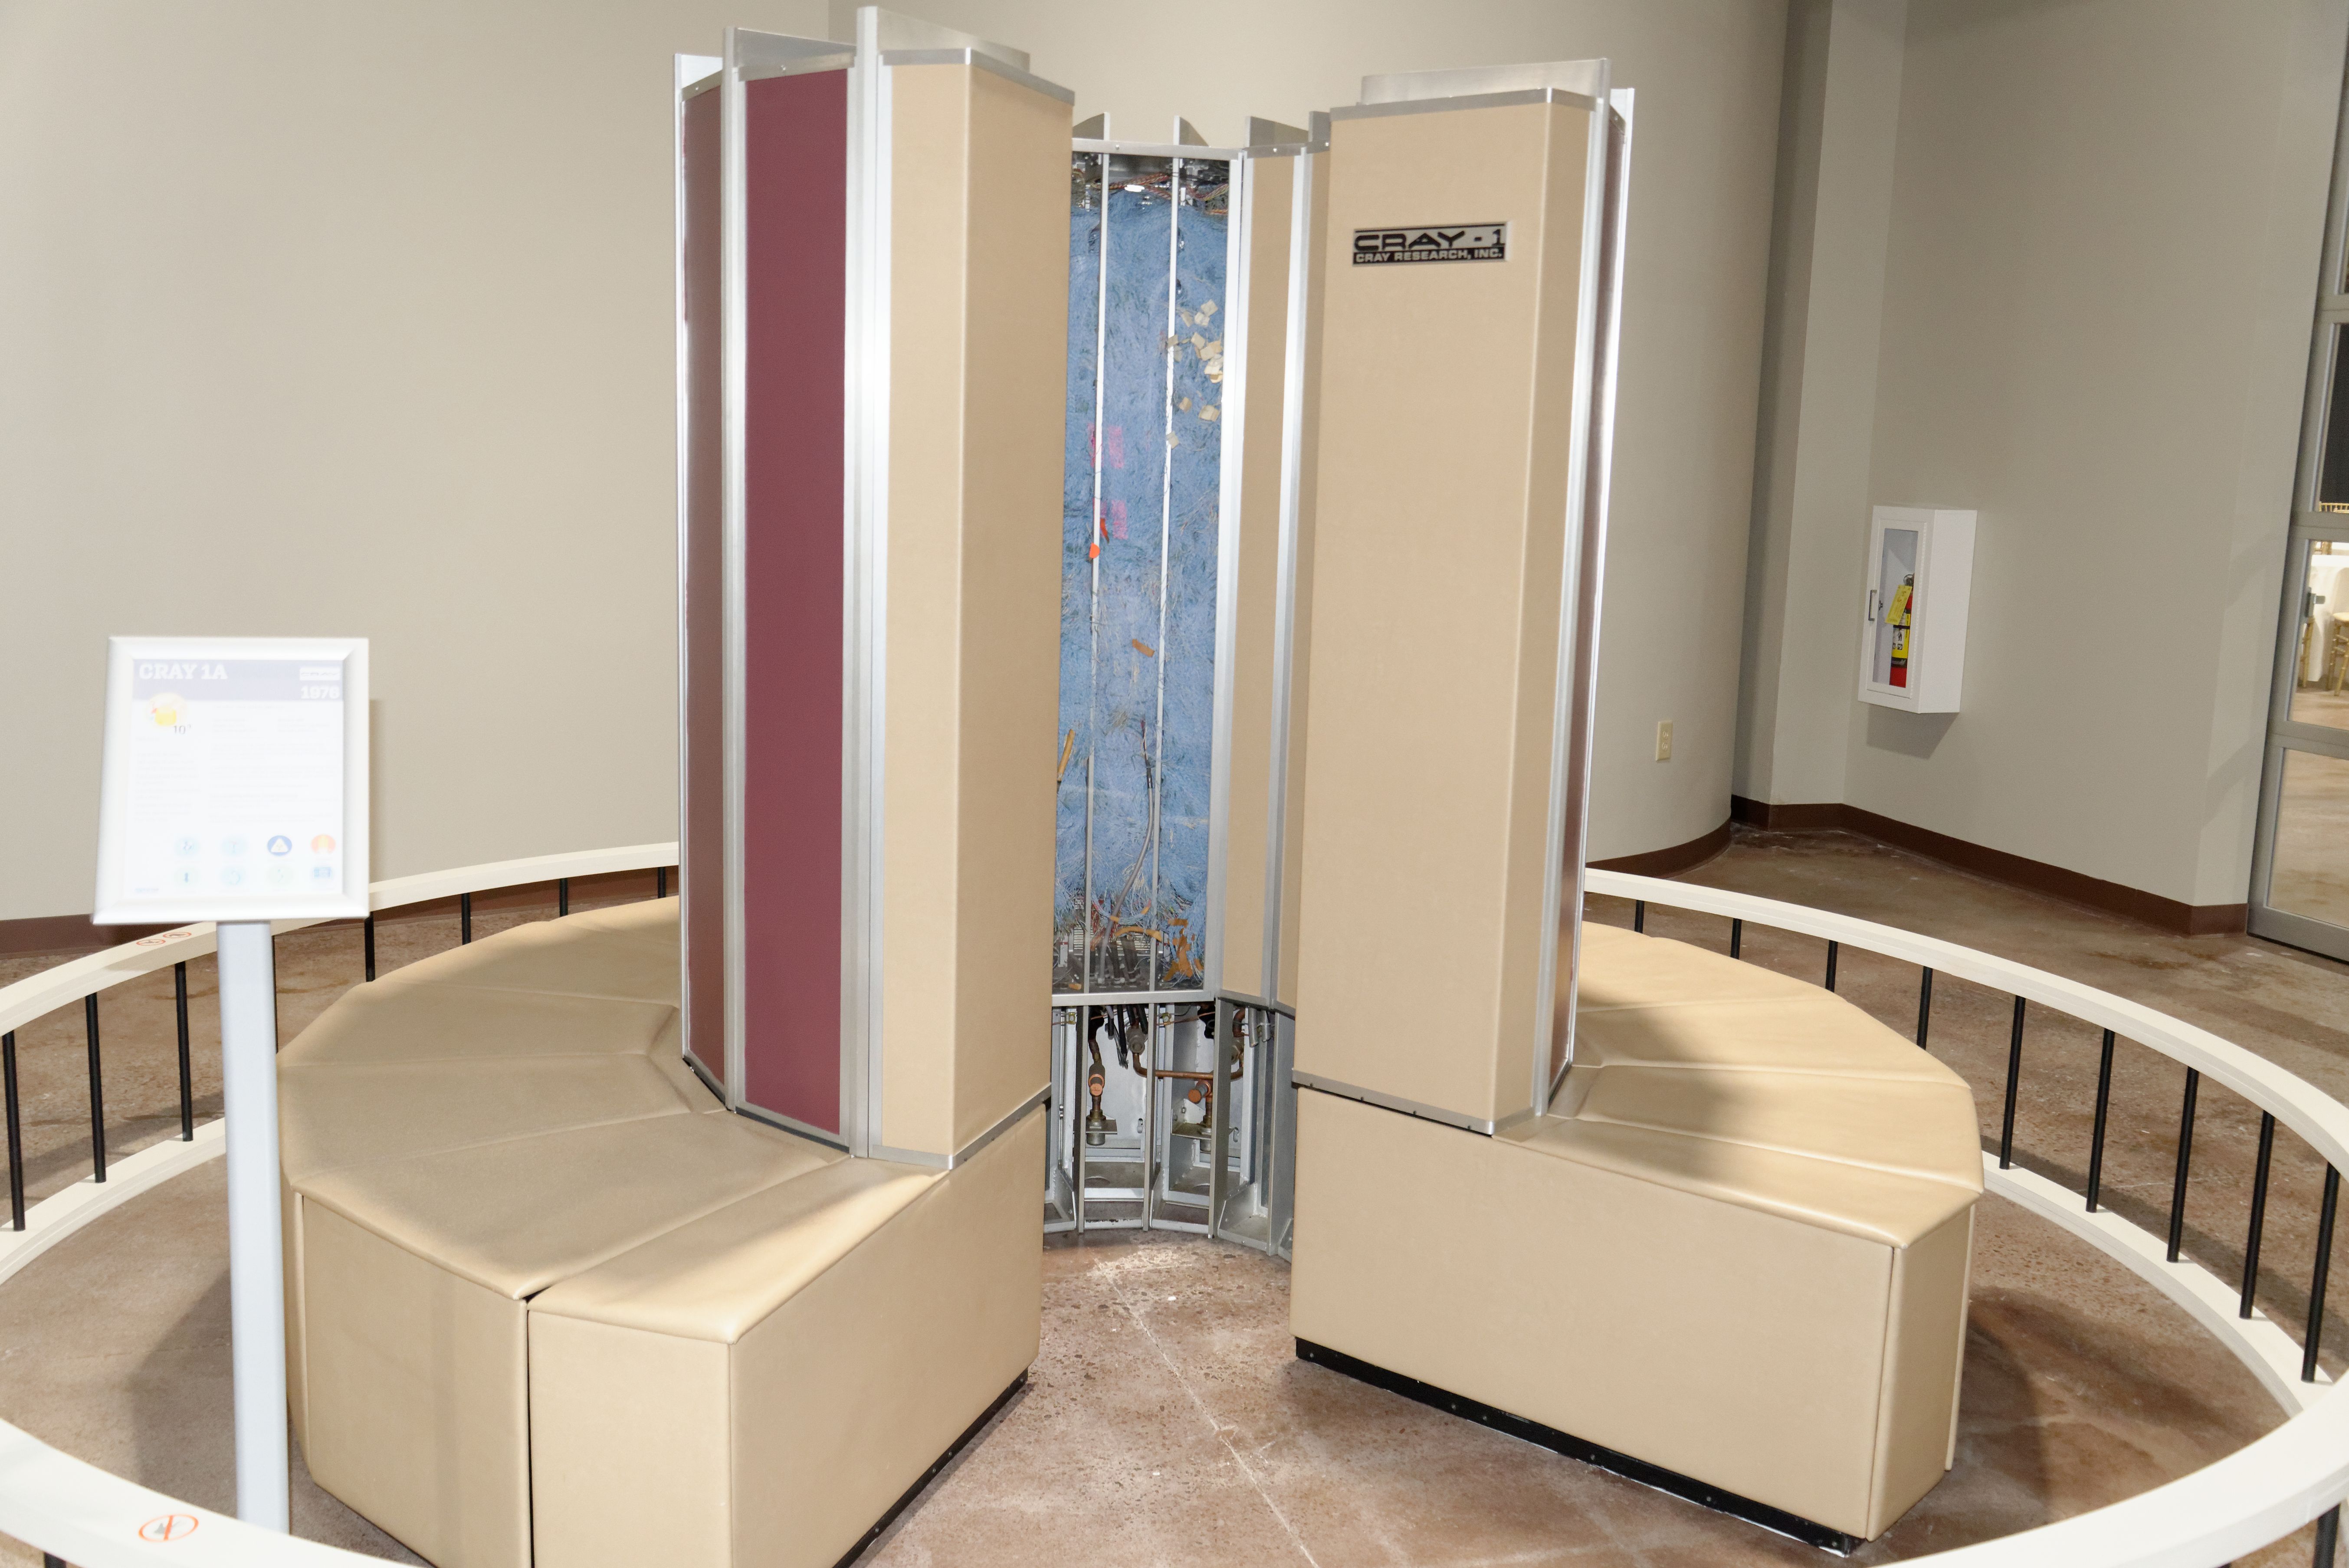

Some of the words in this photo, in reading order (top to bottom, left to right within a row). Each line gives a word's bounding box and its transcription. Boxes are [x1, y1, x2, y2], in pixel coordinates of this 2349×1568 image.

[1355, 253, 1390, 263] CRAY
[1394, 249, 1471, 261] RESEARCH,
[1474, 248, 1502, 259] INC.
[139, 663, 197, 679] CRAY
[201, 663, 228, 679] 1A
